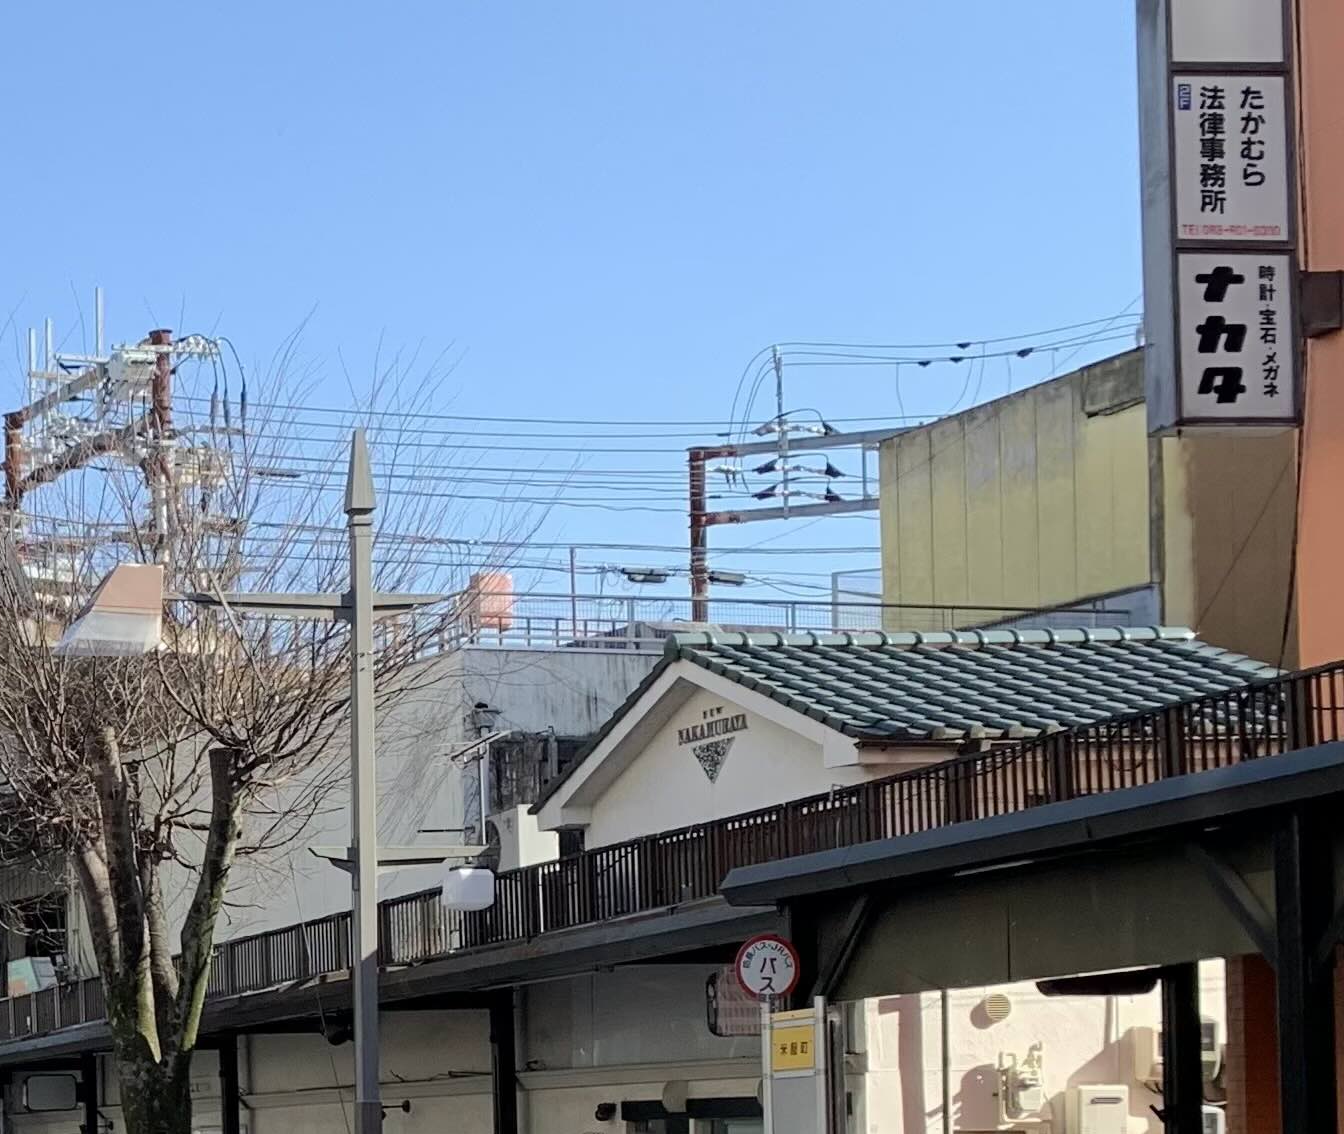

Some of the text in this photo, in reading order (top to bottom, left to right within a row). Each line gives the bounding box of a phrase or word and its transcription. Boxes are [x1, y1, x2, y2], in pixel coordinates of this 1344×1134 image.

[1199, 85, 1226, 214] 法律事務所
[1240, 86, 1266, 187] たかむら
[1195, 266, 1247, 404] ナカタ
[760, 957, 777, 992] バス
